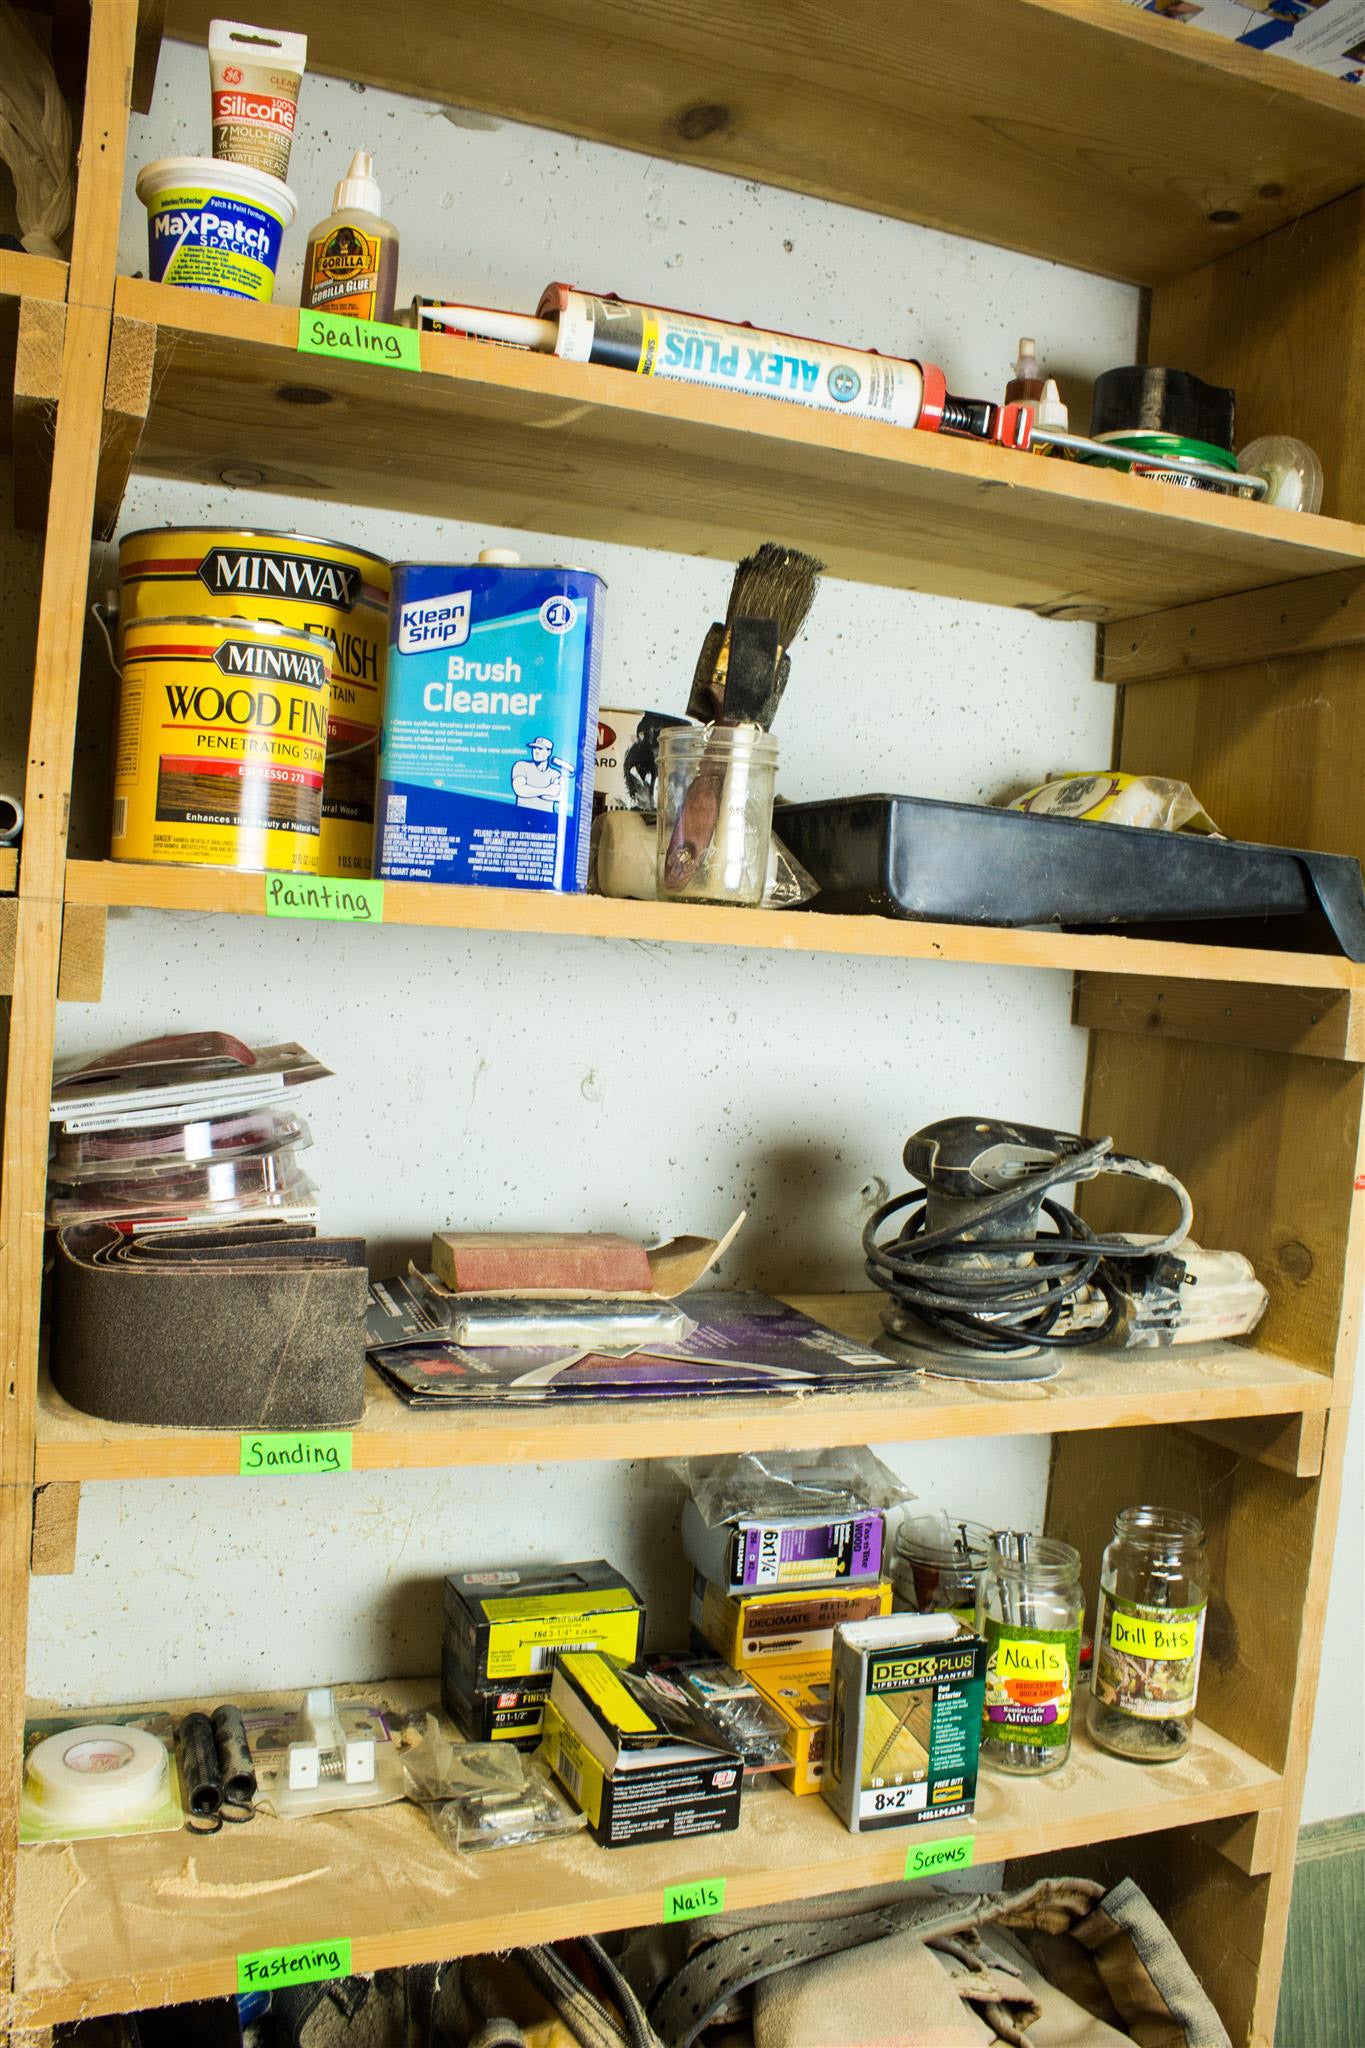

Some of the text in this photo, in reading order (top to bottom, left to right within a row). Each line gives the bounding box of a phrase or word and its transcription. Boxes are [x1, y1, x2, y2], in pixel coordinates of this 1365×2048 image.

[270, 76, 298, 89] CLEAR
[219, 95, 294, 128] Silicone
[272, 98, 295, 114] 100%
[220, 127, 228, 141] 7
[229, 125, 291, 149] MOLD-FREE
[211, 199, 228, 209] Patch
[233, 203, 247, 214] Paint
[154, 211, 270, 255] MaxPatch
[200, 235, 265, 263] SPACKLE
[322, 257, 363, 268] GORILLA
[312, 278, 369, 305] GORILLA GLUE
[310, 321, 402, 358] Sealing
[664, 331, 740, 378] PLUS
[744, 348, 821, 393] ALEX
[216, 553, 356, 604] MINWAX
[402, 604, 465, 627] Klean
[408, 622, 457, 643] Strip
[227, 645, 323, 689] MINWAX
[447, 655, 522, 683] Brush
[164, 685, 281, 728] WOOD
[329, 684, 356, 704] TAIN
[423, 682, 543, 716] Cleaner
[196, 734, 324, 763] PENETRATING STAIN
[238, 766, 305, 783] ESPRESSO 273
[185, 812, 230, 824] Enhances
[281, 821, 290, 829] of
[290, 822, 311, 833] Natural
[269, 879, 372, 919] Painting
[246, 1442, 341, 1473] Sanding
[853, 1522, 862, 1552] WOOD
[749, 1614, 811, 1629] DECKMATE
[1115, 1624, 1189, 1649] Drill Bits
[876, 1654, 972, 1680] DECK PLUS
[1004, 1649, 1060, 1670] Nails
[872, 1669, 972, 1689] LIFETIME GUARANTEE
[938, 1683, 951, 1693] Red
[937, 1690, 962, 1701] Exterior
[1005, 1713, 1043, 1723] Alfredo
[933, 1779, 950, 1790] FREE
[917, 1805, 966, 1821] HILLMAN
[912, 1846, 966, 1872] Screws
[672, 1888, 718, 1915] Nails
[243, 1950, 341, 1982] Fastening
